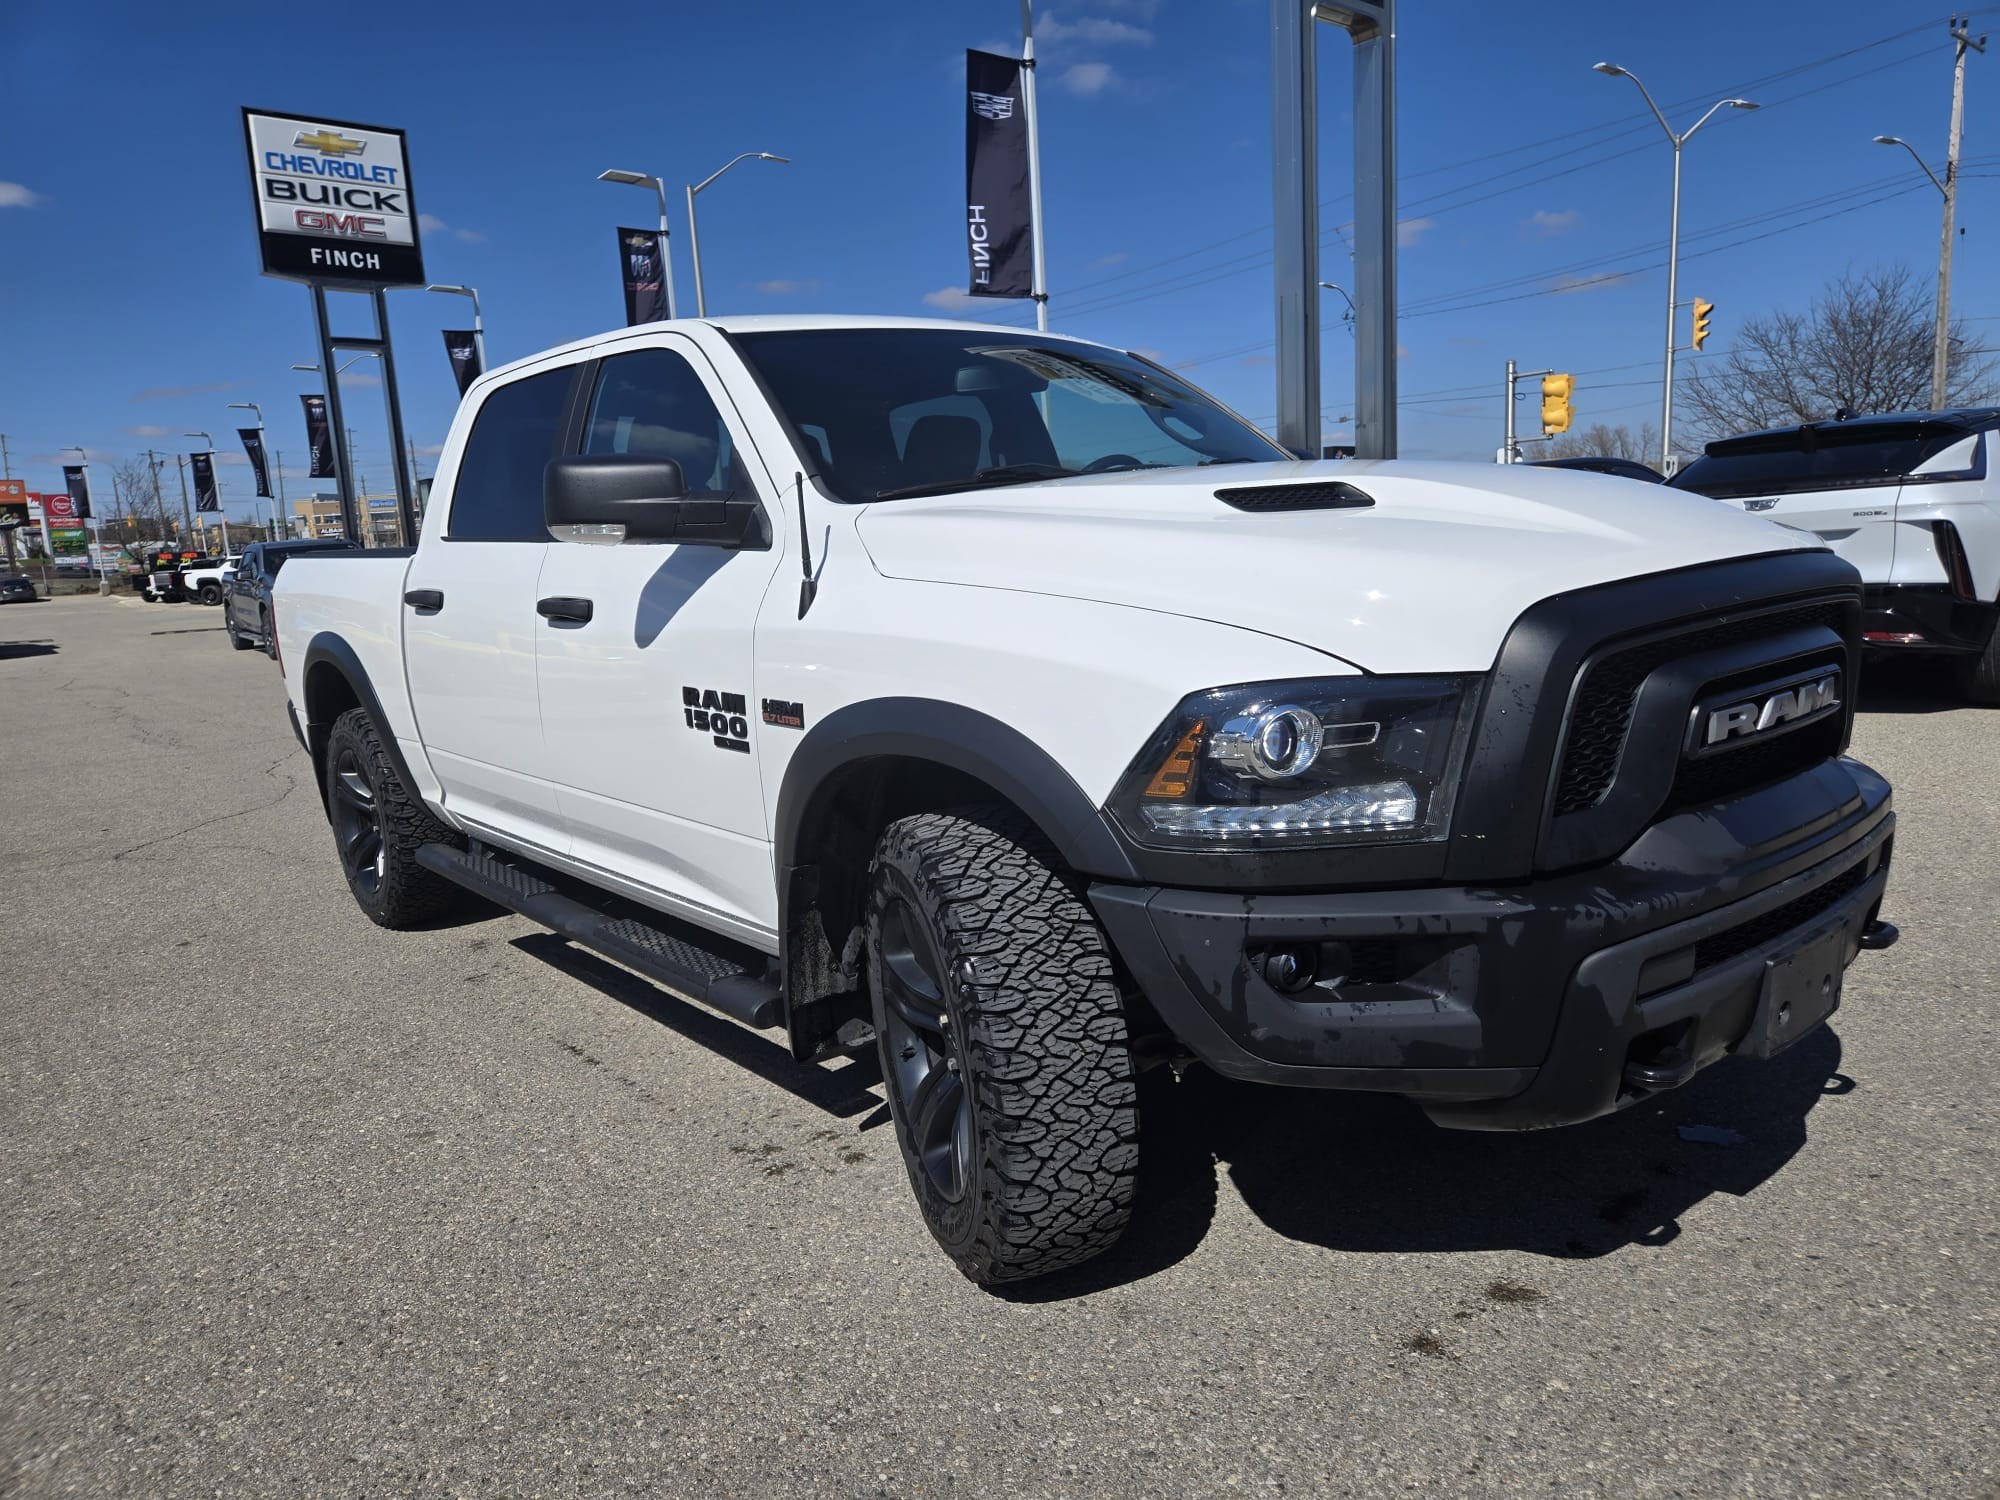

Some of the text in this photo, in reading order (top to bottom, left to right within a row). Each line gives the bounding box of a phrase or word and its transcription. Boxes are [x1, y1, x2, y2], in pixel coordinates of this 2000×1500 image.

[265, 151, 398, 185] CHEVROLET
[265, 178, 404, 213] BUICK
[294, 209, 387, 237] GMC
[310, 247, 381, 270] FINCH
[682, 686, 747, 717] RAM
[1707, 676, 1835, 745] RAM
[684, 707, 748, 739] 1500
